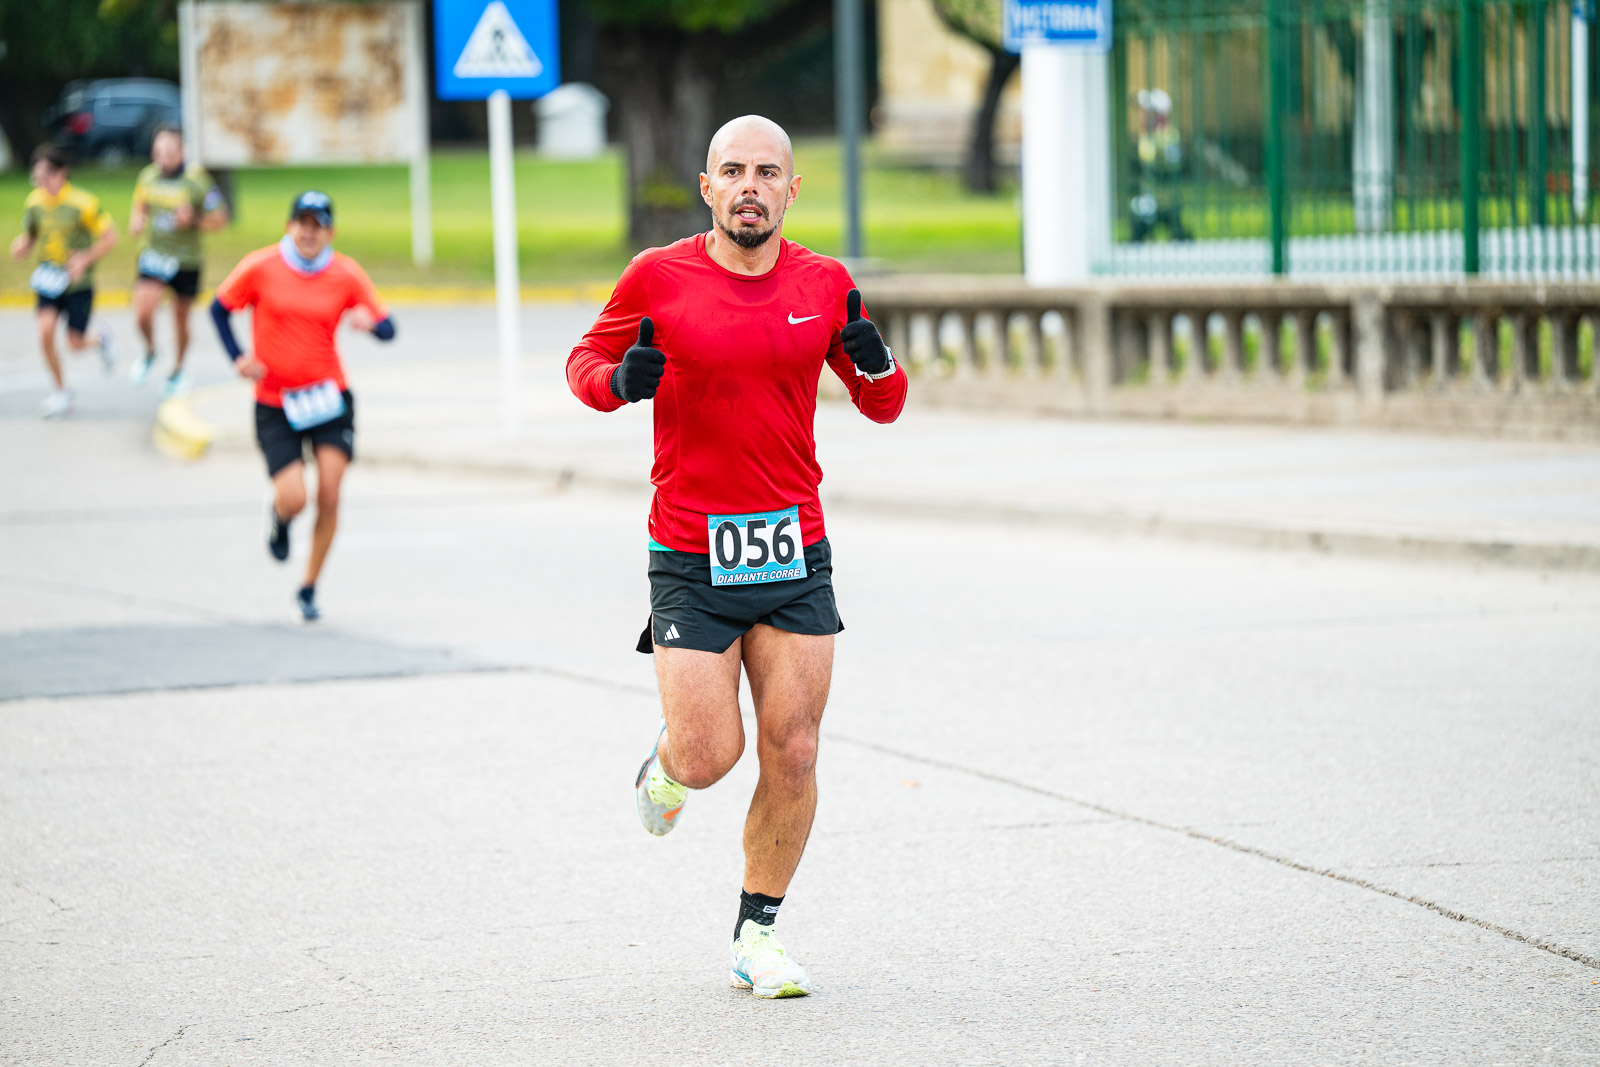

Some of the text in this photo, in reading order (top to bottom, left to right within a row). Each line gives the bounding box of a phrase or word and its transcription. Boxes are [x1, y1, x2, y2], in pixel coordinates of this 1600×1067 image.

[715, 516, 796, 571] 056
[716, 567, 801, 584] DIAMANTE CORRE
